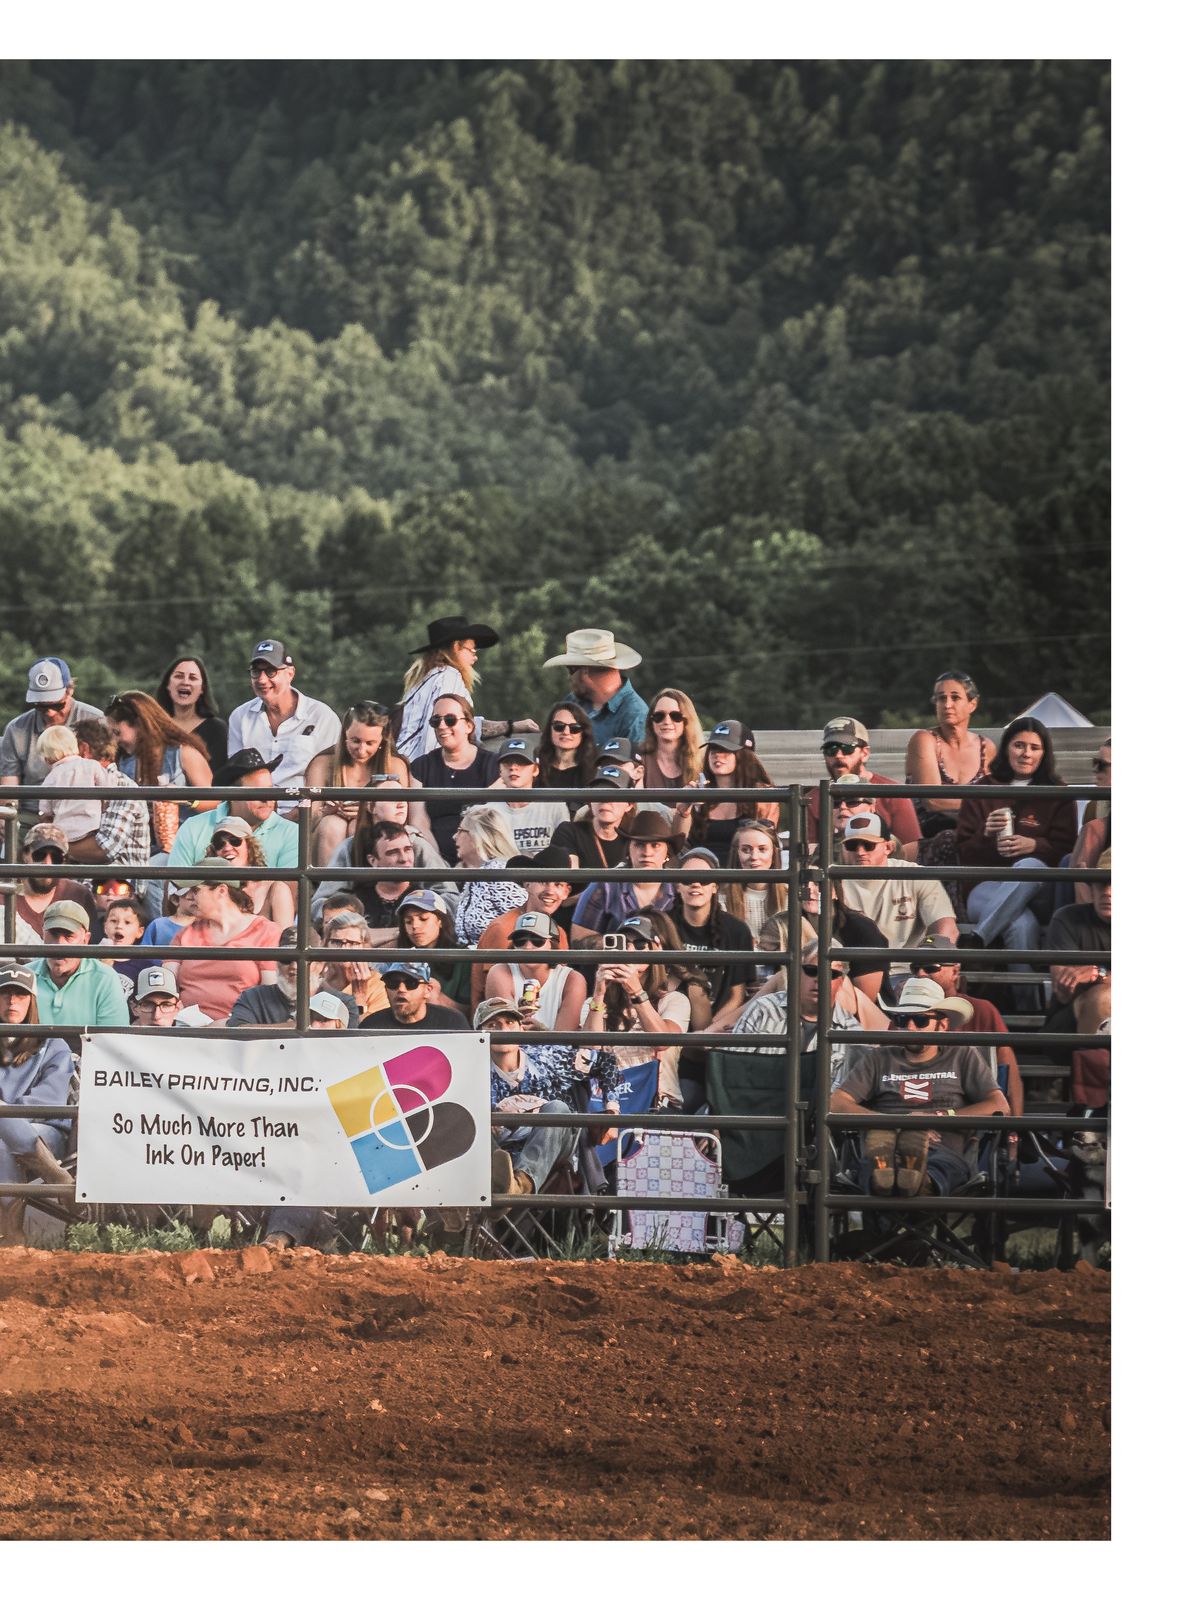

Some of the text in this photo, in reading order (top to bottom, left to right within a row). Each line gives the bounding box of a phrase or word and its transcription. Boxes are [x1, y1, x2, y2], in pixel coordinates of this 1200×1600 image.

[94, 1070, 320, 1095] BAILEY PRINTING, INC.
[919, 1071, 958, 1080] CENTRAL
[112, 1112, 299, 1138] So Much More Than
[146, 1143, 267, 1171] Ink On Paper!
